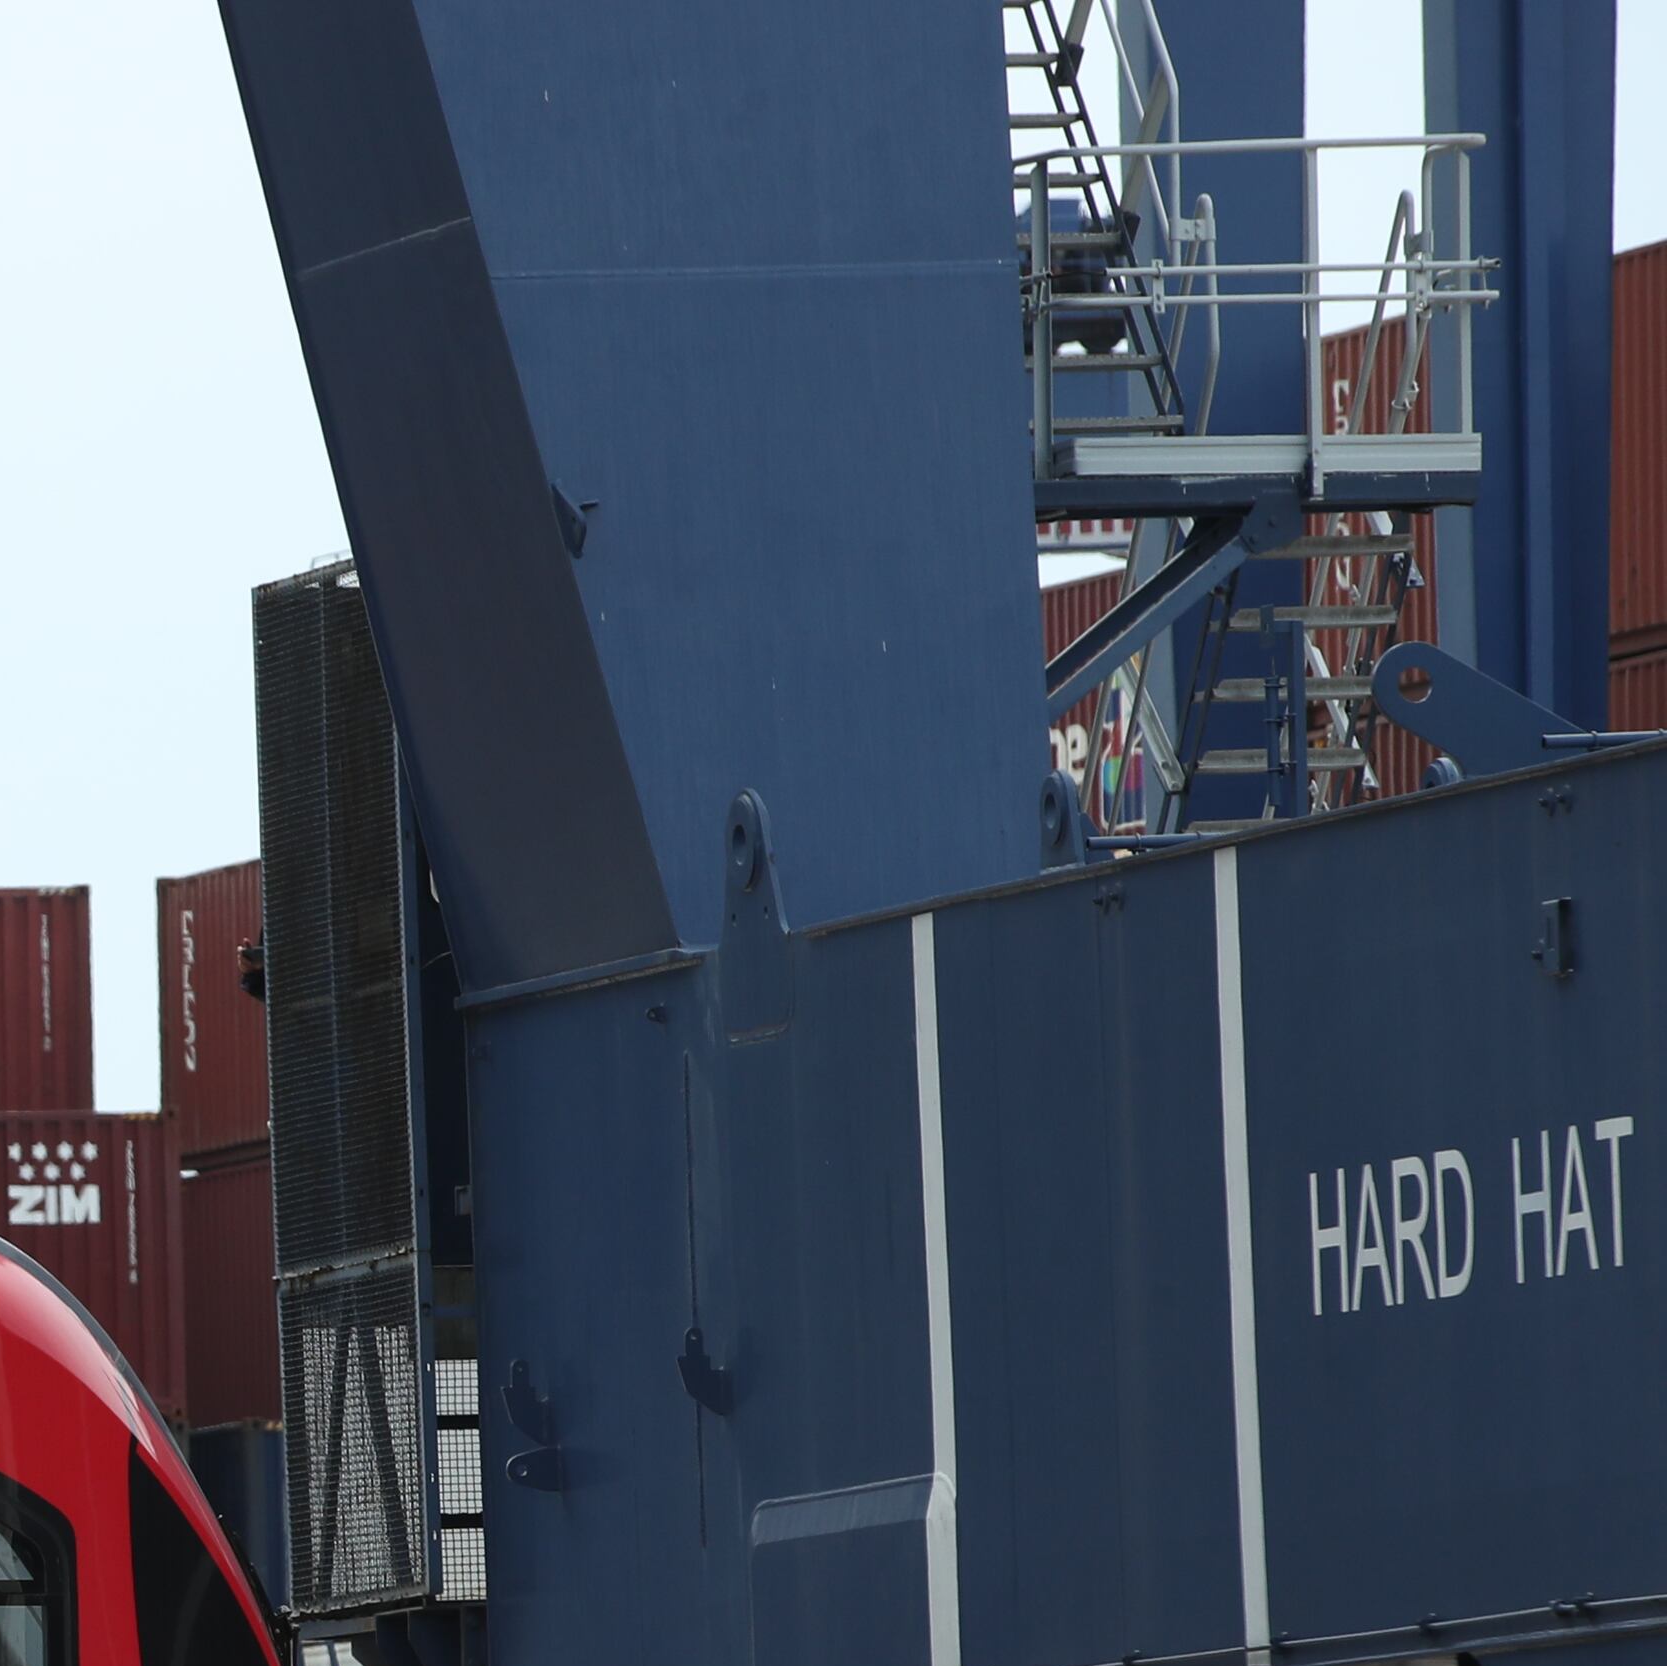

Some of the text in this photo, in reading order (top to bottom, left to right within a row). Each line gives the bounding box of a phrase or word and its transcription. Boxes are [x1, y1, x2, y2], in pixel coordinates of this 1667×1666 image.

[8, 1184, 101, 1225] ZIM
[1309, 1116, 1634, 1316] HARD HAT
